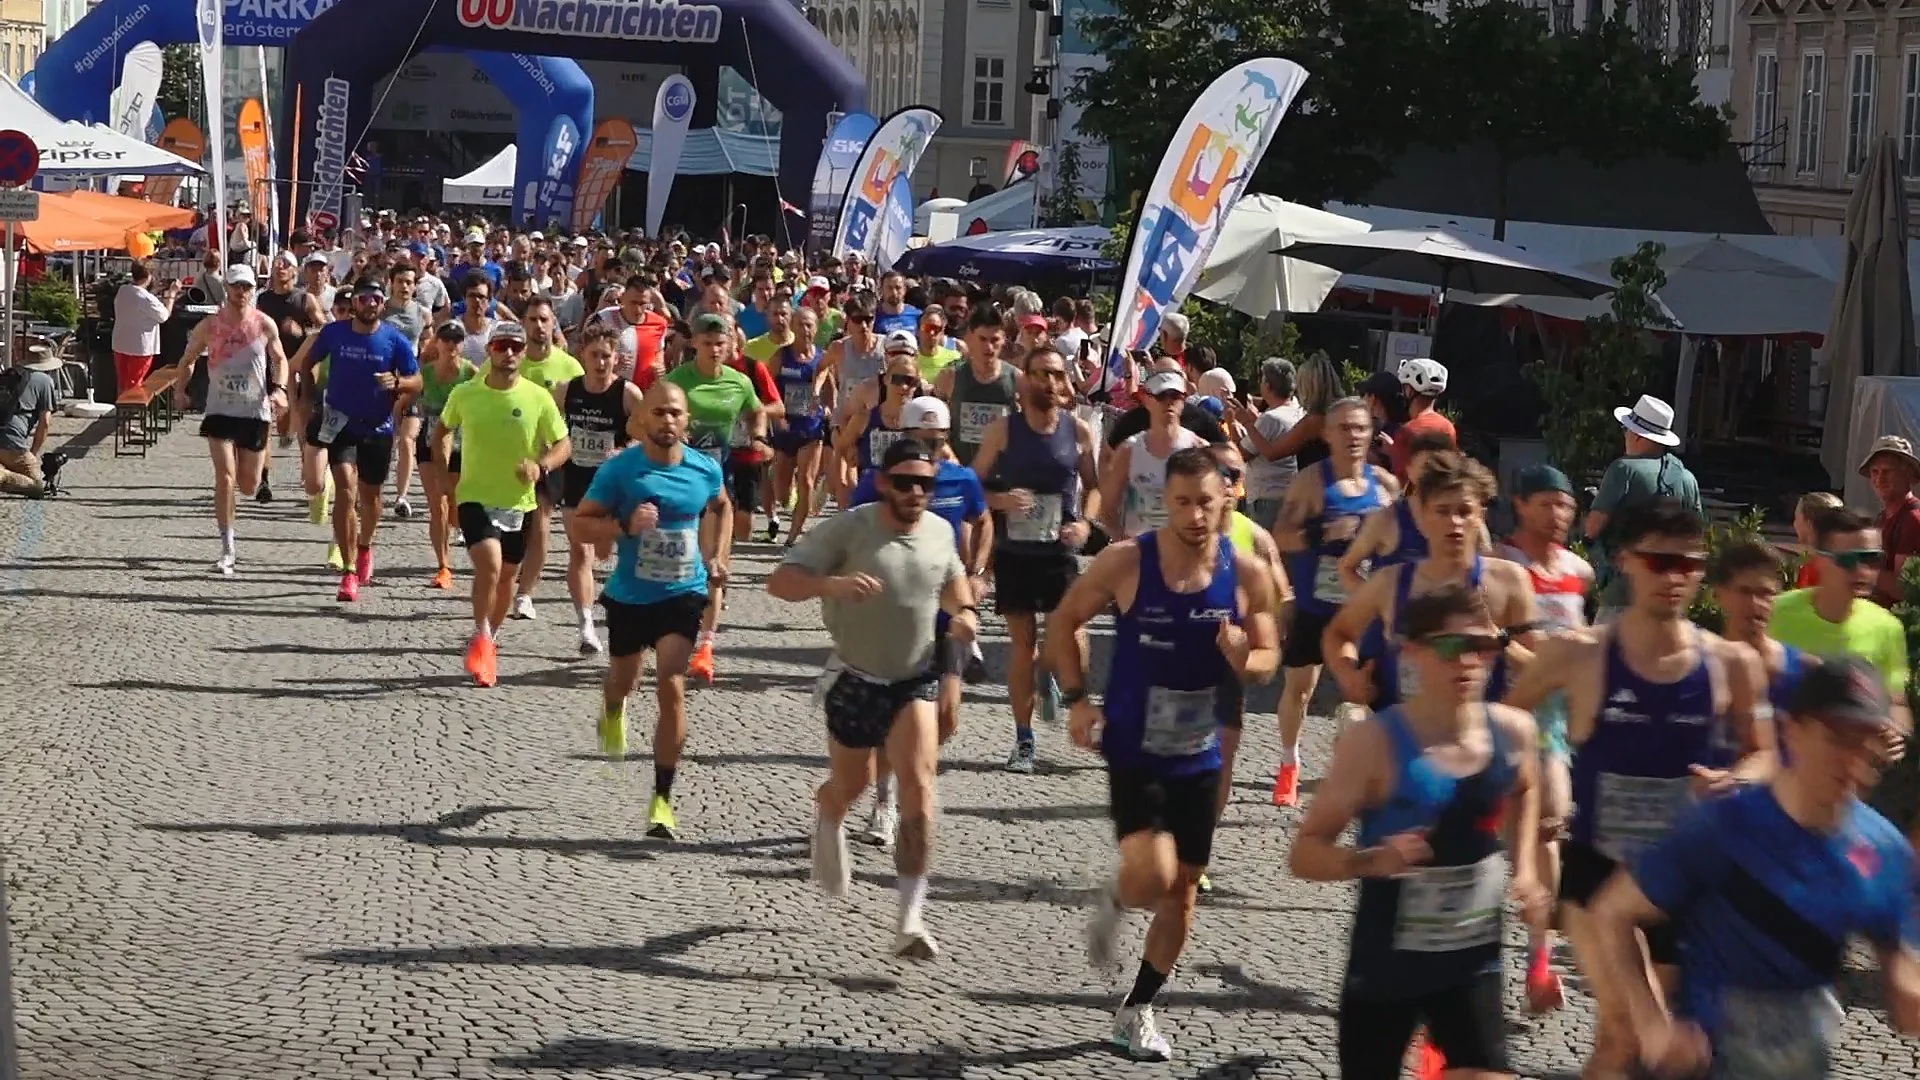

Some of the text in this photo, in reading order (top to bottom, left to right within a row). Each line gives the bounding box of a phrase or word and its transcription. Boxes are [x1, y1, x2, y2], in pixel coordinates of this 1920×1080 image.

[74, 3, 151, 74] #glaubandich
[38, 148, 127, 163] Zipfer
[581, 438, 605, 451] 184
